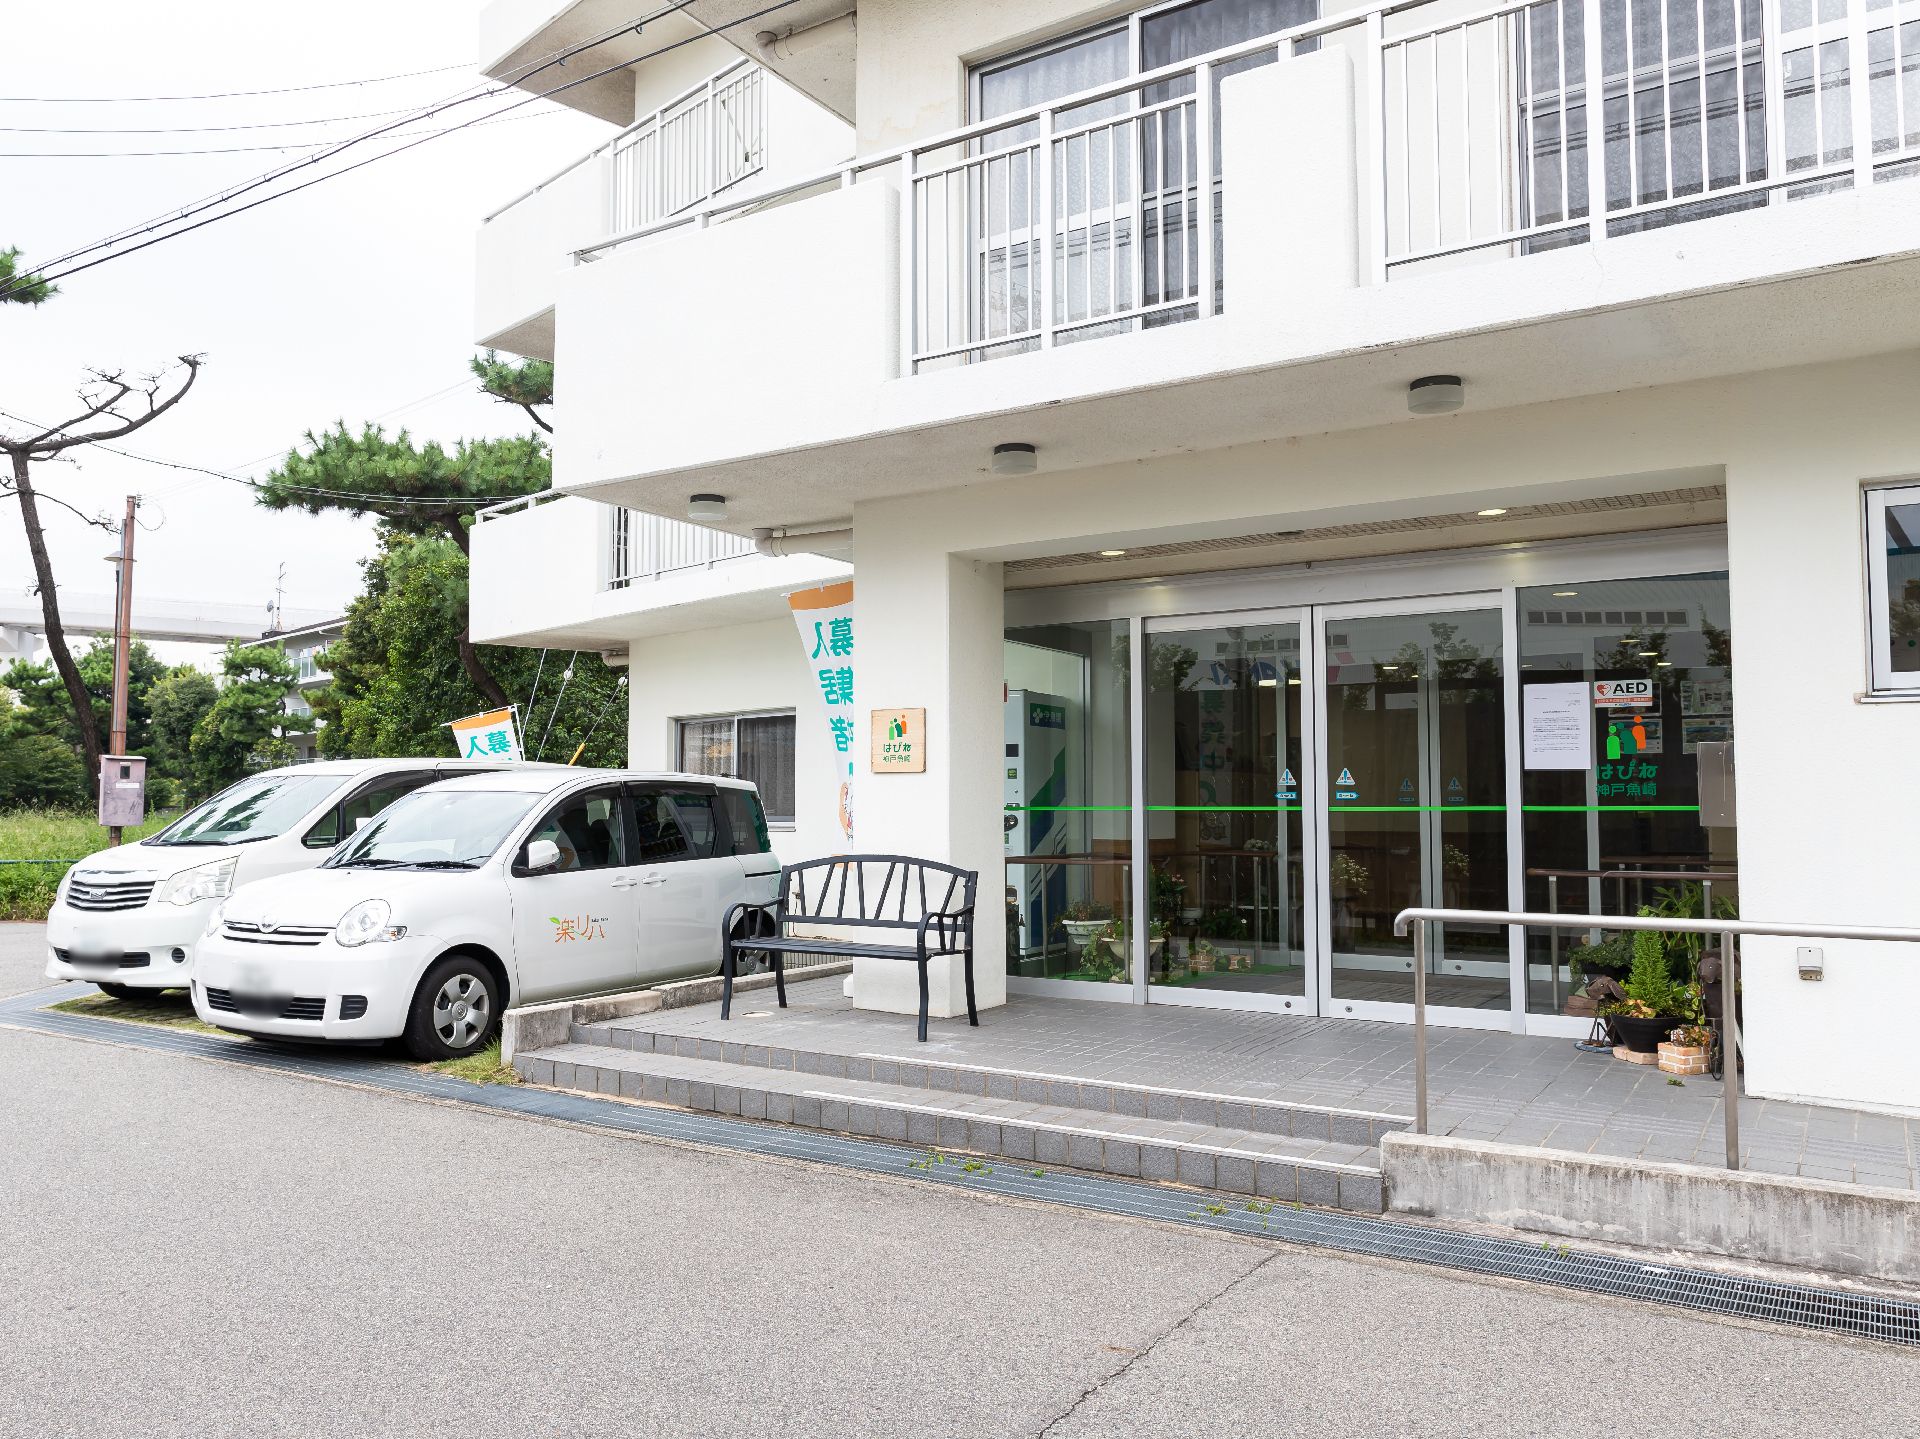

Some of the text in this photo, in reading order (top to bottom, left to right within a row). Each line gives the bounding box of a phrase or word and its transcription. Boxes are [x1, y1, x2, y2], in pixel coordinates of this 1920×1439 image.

[1613, 682, 1648, 694] AED
[882, 742, 912, 753] はぴね
[1596, 759, 1658, 780] はぴね
[1596, 783, 1657, 797] 神戸魚崎
[555, 914, 605, 943] 楽リハ
